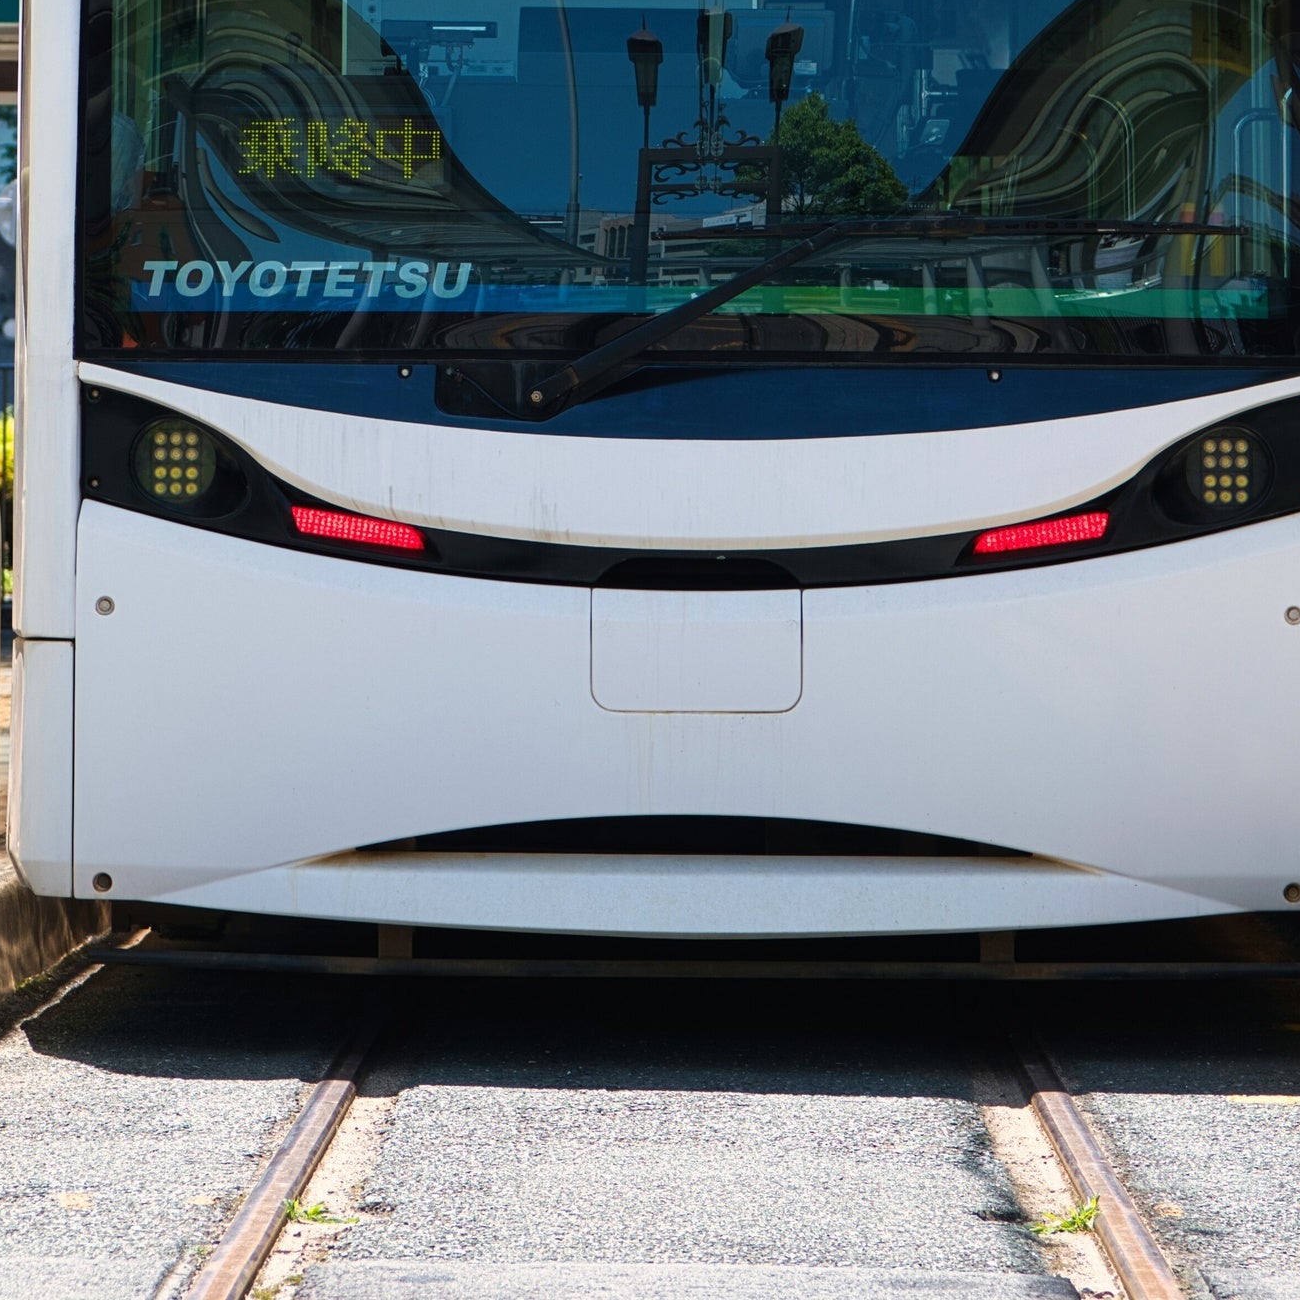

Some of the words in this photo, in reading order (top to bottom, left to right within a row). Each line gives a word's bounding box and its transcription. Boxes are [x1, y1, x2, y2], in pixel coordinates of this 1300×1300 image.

[238, 118, 440, 179] 乗降中
[143, 260, 473, 299] TOYOTETSU
